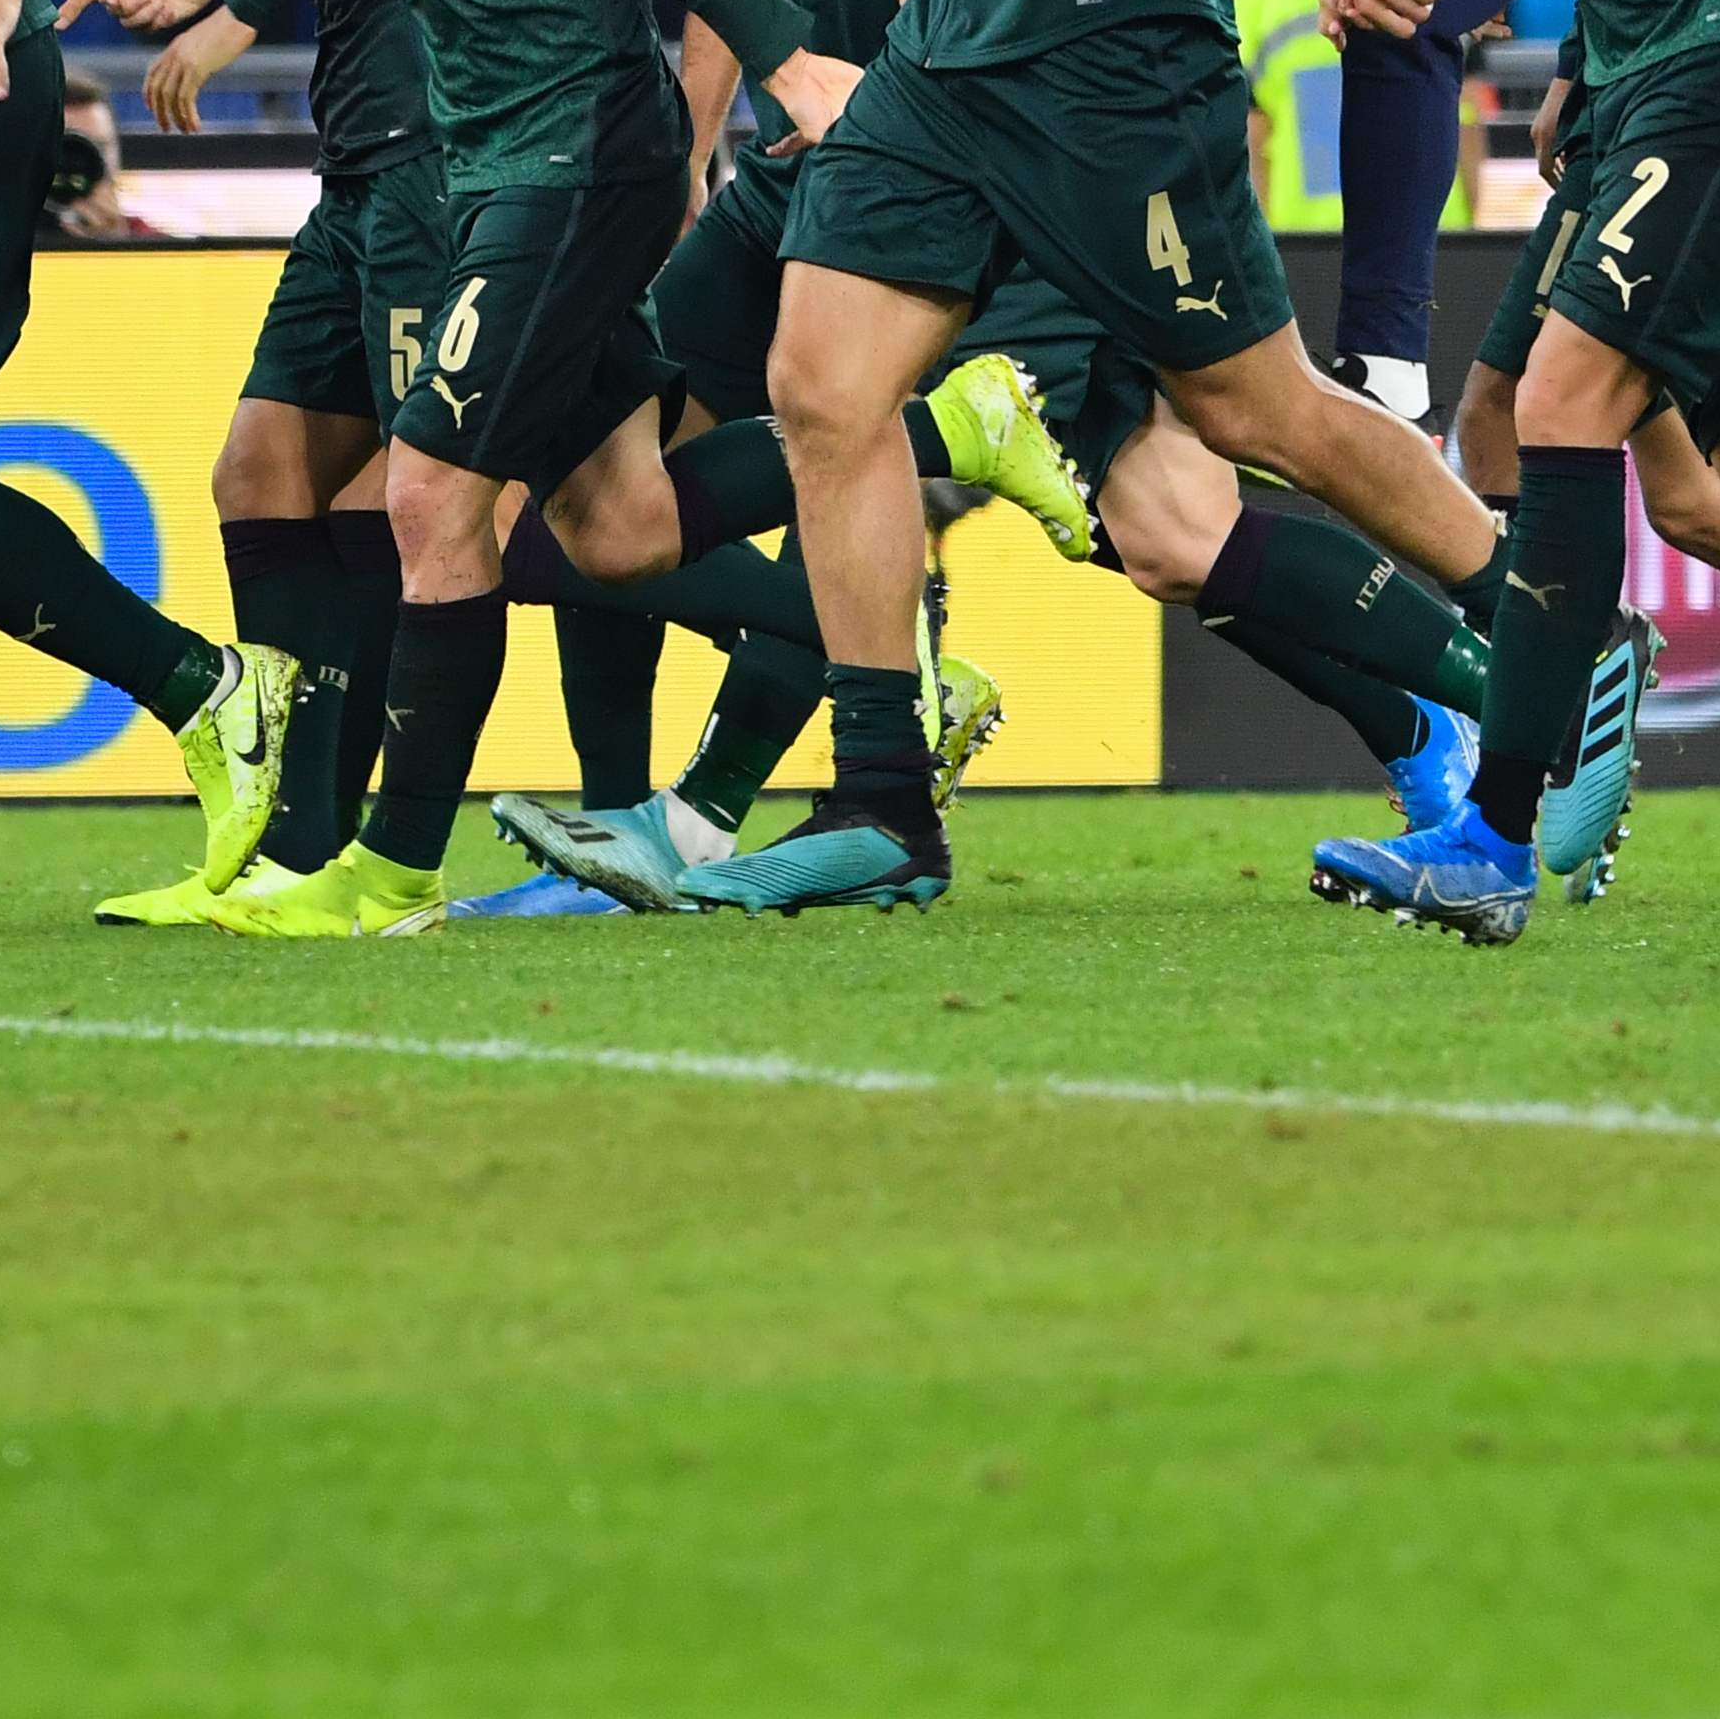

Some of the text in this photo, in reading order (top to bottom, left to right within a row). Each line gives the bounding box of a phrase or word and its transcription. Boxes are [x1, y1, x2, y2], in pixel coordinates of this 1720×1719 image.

[1146, 190, 1194, 287] 4
[1535, 208, 1582, 296] 1
[1597, 156, 1671, 254] 2
[437, 276, 488, 373] 6
[1354, 556, 1396, 613] ITALI
